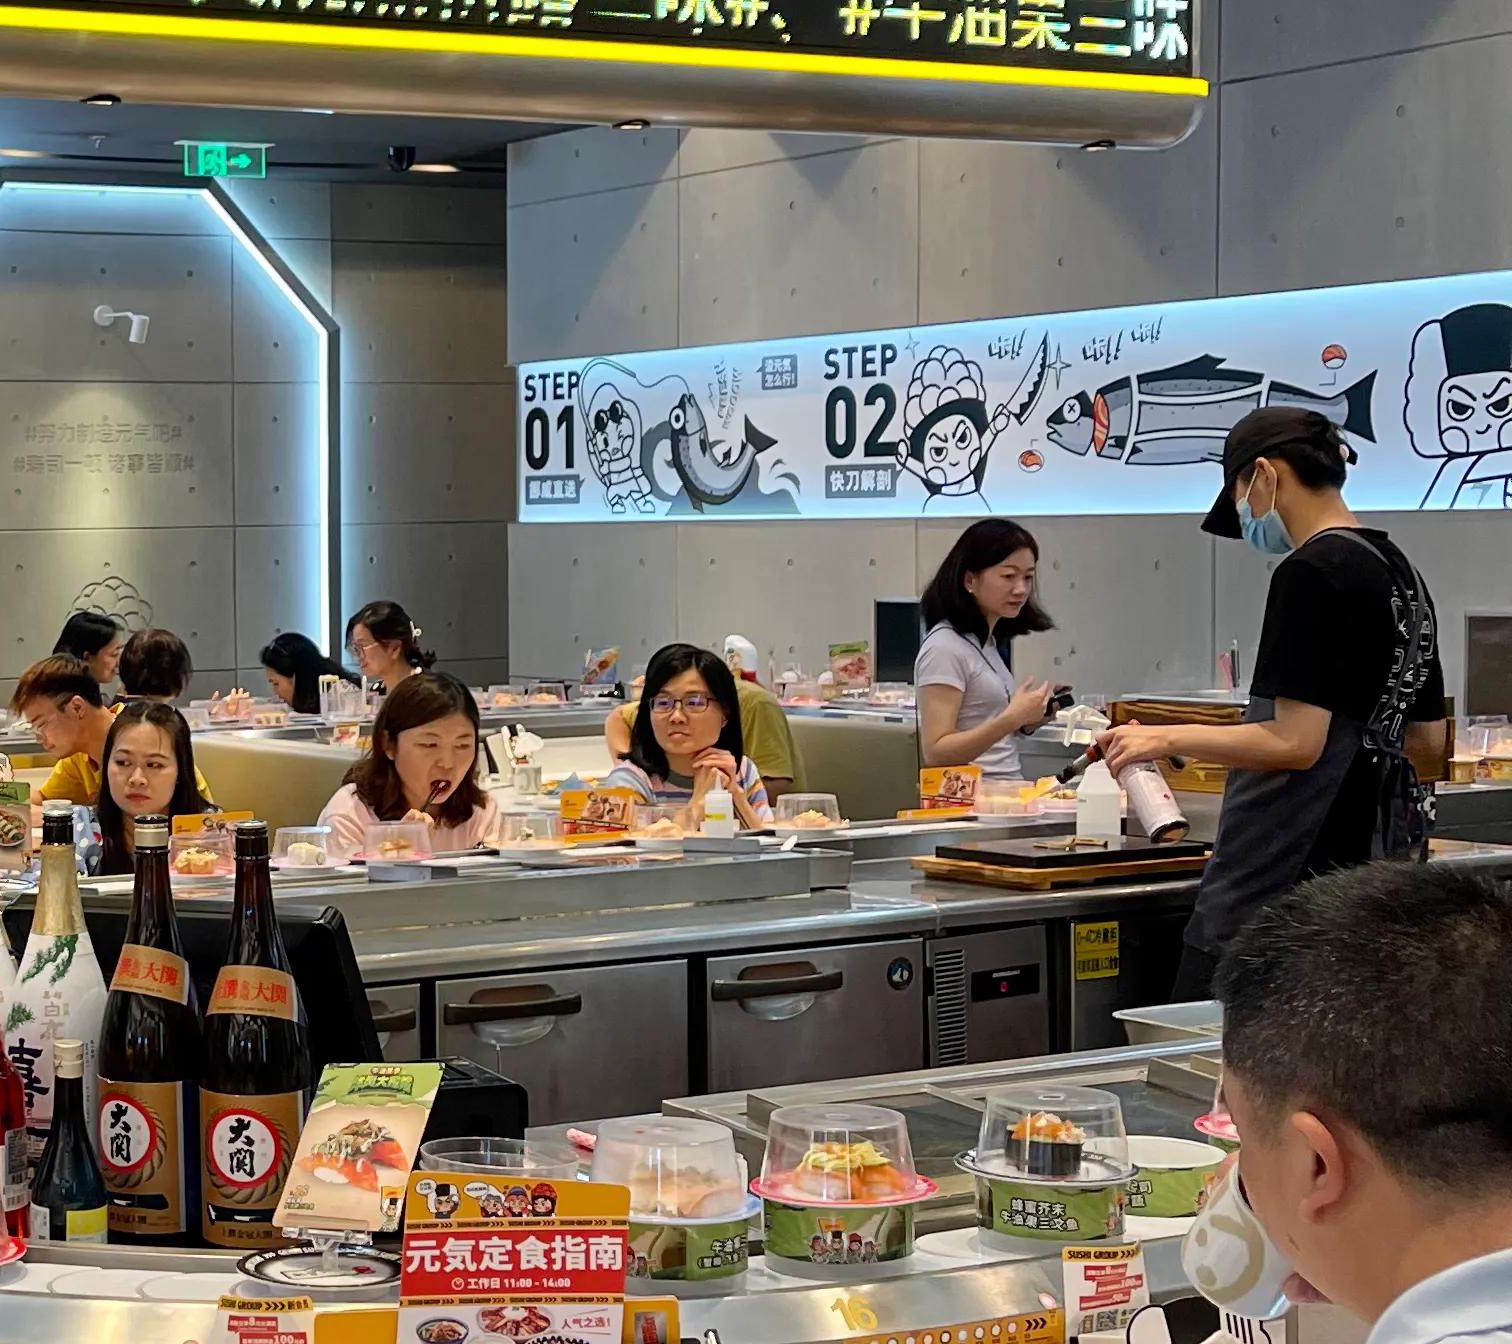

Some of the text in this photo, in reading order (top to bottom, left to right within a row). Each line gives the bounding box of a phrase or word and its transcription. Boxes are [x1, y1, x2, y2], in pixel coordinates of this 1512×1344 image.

[824, 343, 897, 381] STEP
[525, 371, 579, 402] STEP
[526, 405, 576, 470] 01
[825, 383, 899, 459] 02
[829, 469, 892, 493] 快刀解剖
[406, 1234, 624, 1273] 元気定食指南
[1068, 1249, 1092, 1260] SUSHI
[466, 1277, 501, 1290] 工作日
[503, 1278, 532, 1289] 11:00
[542, 1278, 571, 1288] 14:00
[830, 1296, 879, 1331] 16
